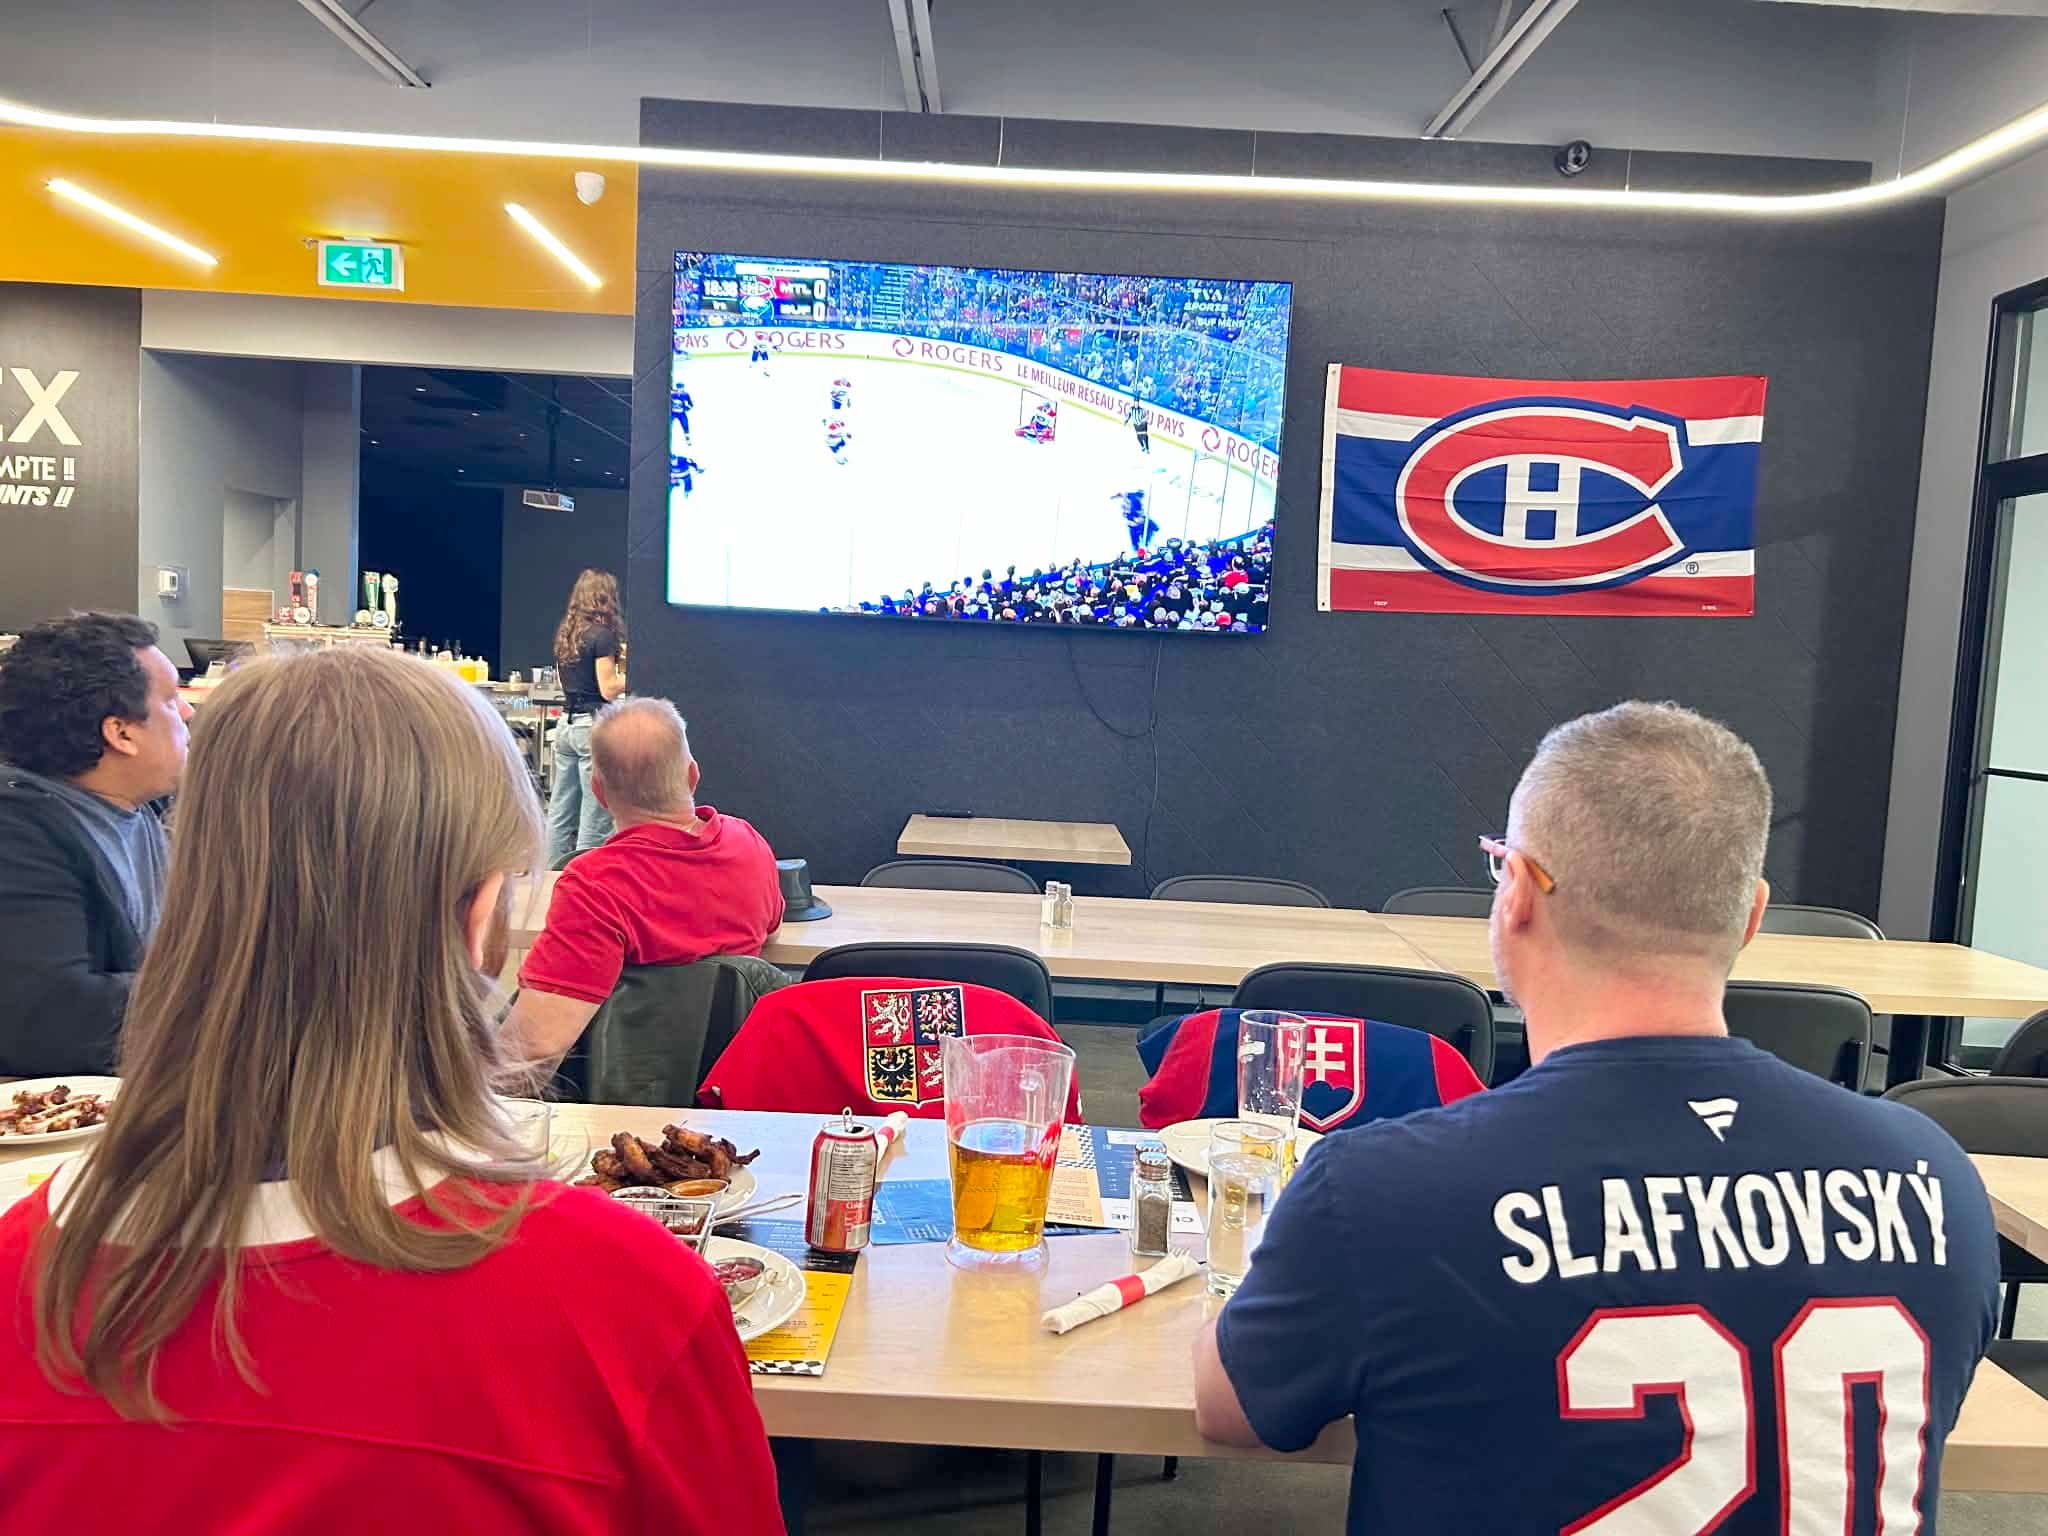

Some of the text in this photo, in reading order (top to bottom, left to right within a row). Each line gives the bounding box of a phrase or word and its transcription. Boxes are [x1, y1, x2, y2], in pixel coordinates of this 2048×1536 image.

[780, 282, 812, 297] MTL
[814, 279, 826, 300] 0
[1191, 287, 1223, 302] TVA
[813, 301, 826, 322] 0
[1183, 302, 1229, 313] SPORTS
[921, 341, 1003, 372] ROGERS
[0, 367, 82, 446] X
[1017, 363, 1029, 379] LE
[1031, 367, 1076, 397] MEILLEUR
[1077, 382, 1115, 411] RÉSEAU
[1156, 413, 1185, 438] PAYS
[1493, 1159, 1948, 1285] SLAFKOVSKÝ
[1555, 1295, 1931, 1536] 20
